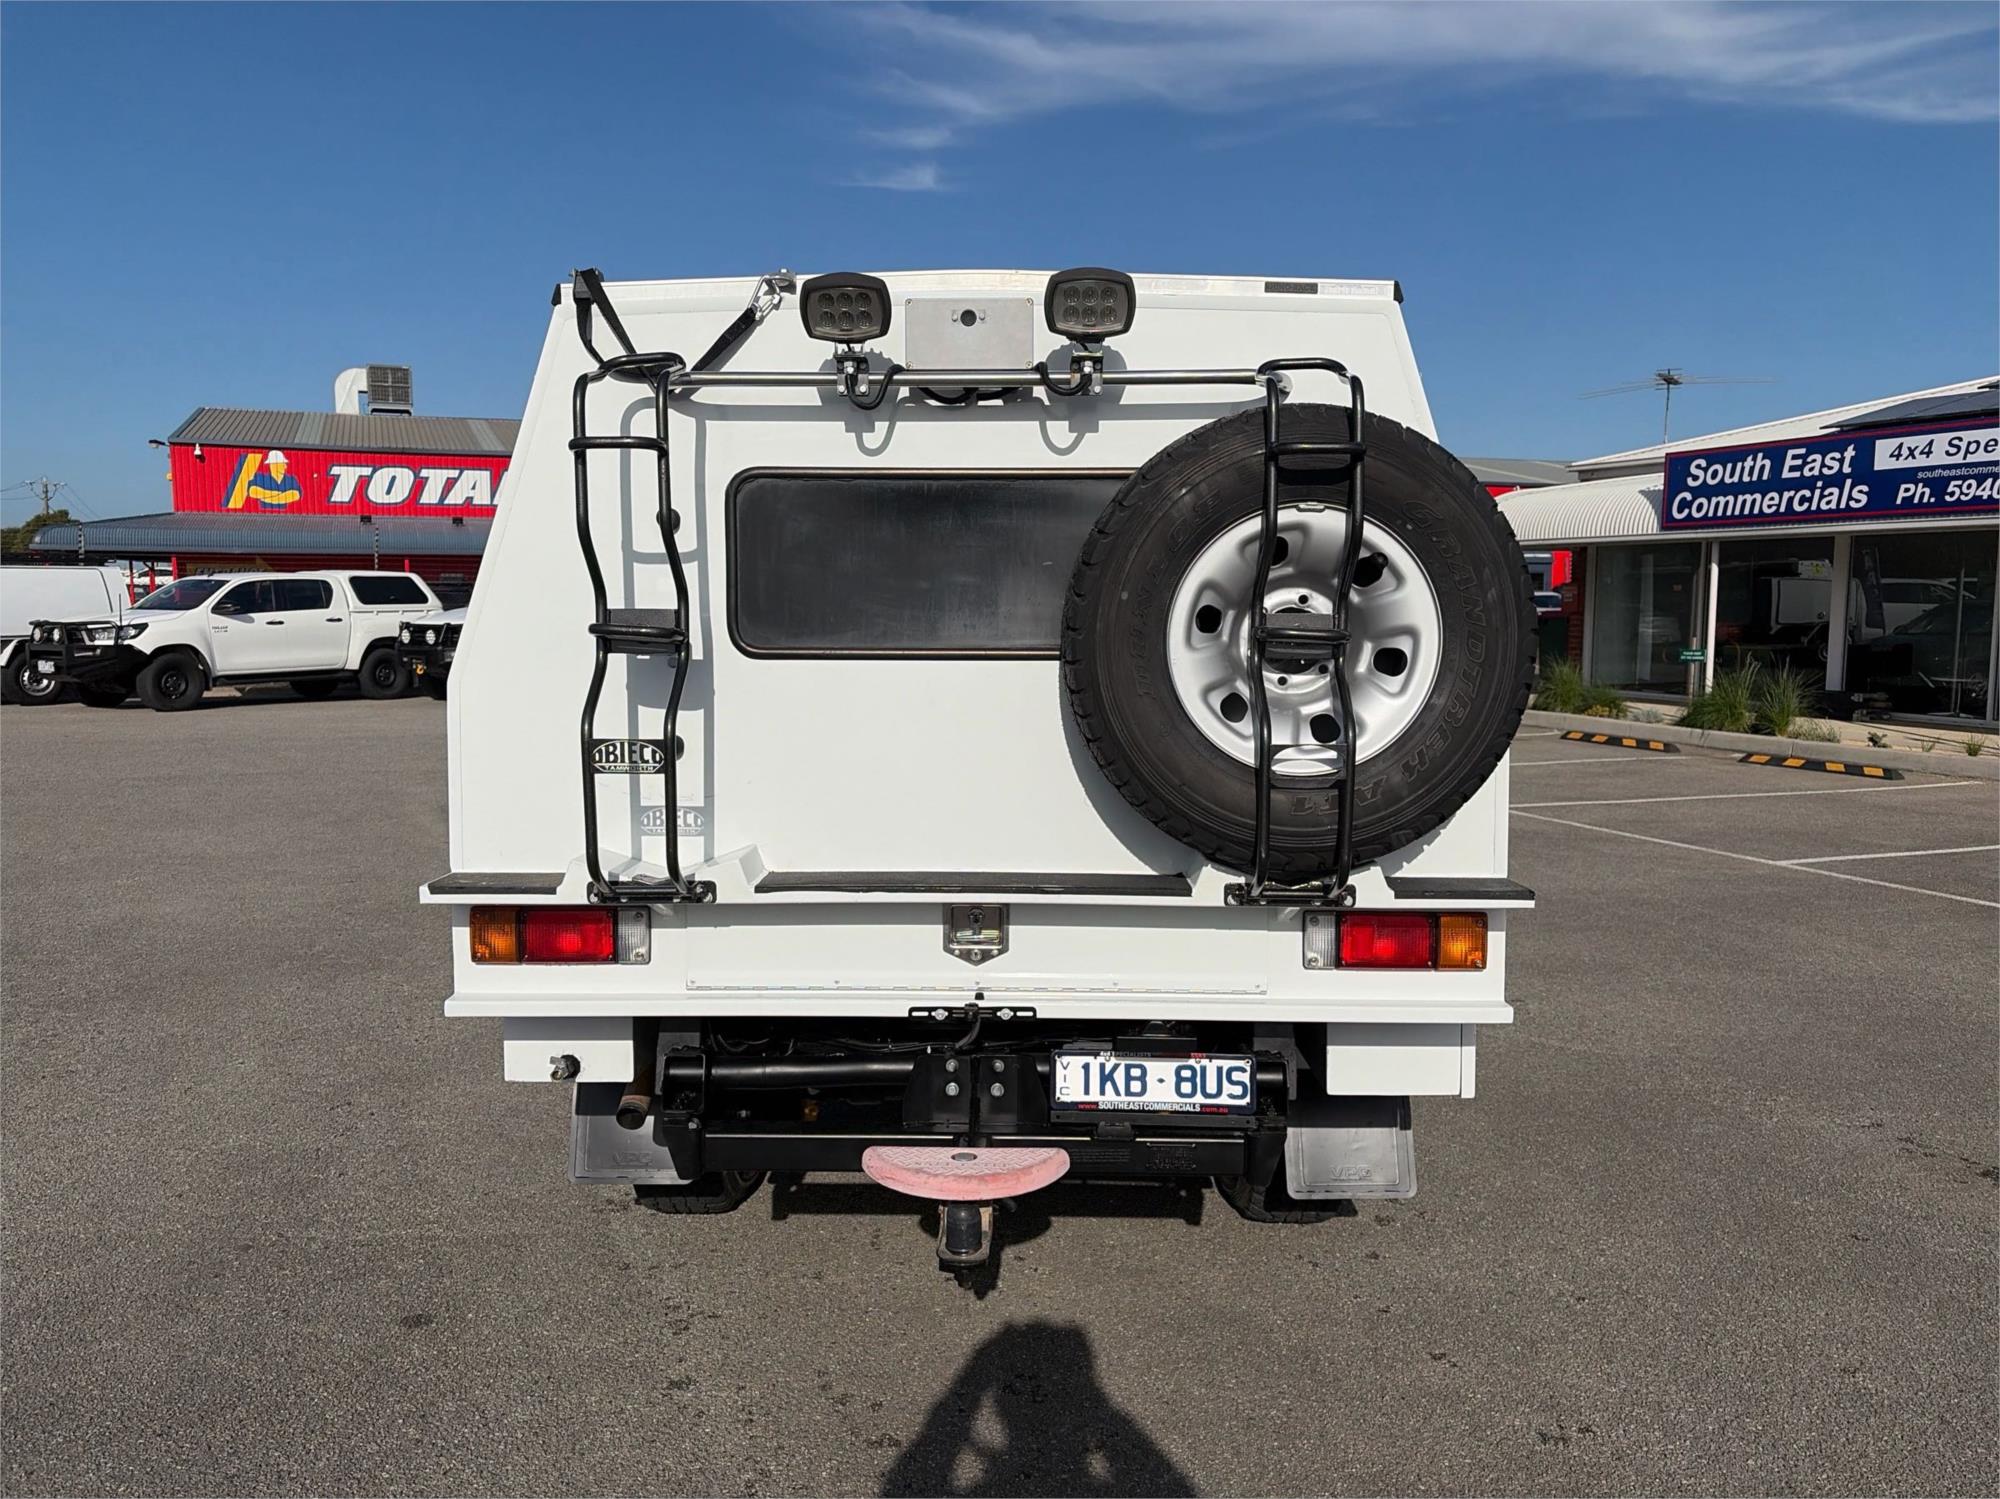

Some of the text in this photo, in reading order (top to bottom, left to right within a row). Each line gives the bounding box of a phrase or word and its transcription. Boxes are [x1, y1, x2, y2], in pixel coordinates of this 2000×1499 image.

[1686, 443, 1857, 487] South East
[1889, 436, 1999, 462] 4x4 Spe
[1671, 478, 1870, 520] Commercials
[1895, 482, 1937, 505] Ph.
[1400, 500, 1488, 784] GRANDTREK
[1059, 1060, 1071, 1096] VIC
